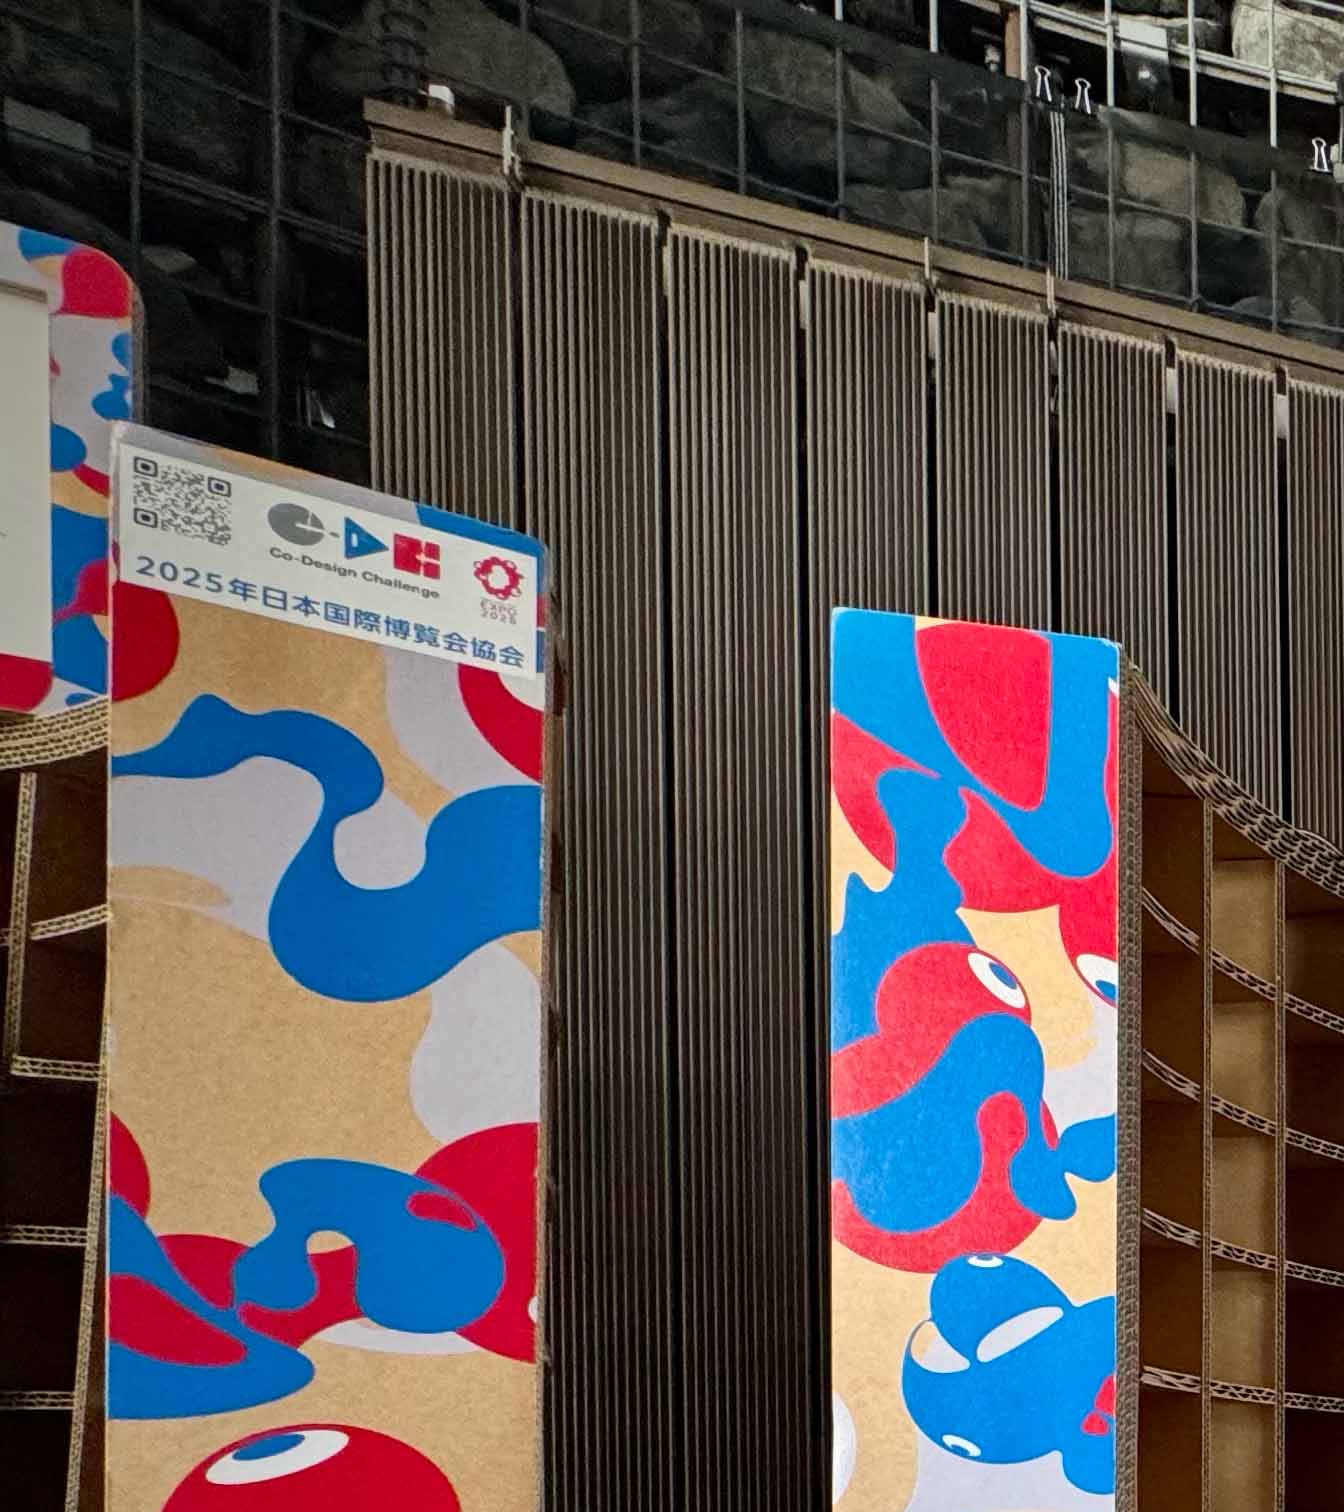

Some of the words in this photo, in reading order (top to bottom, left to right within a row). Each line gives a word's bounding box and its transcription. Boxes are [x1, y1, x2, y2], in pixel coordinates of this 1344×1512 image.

[137, 556, 526, 668] 2025年日本国際博覧会協会
[270, 547, 357, 577] Co-Design
[363, 571, 440, 599] Challenge
